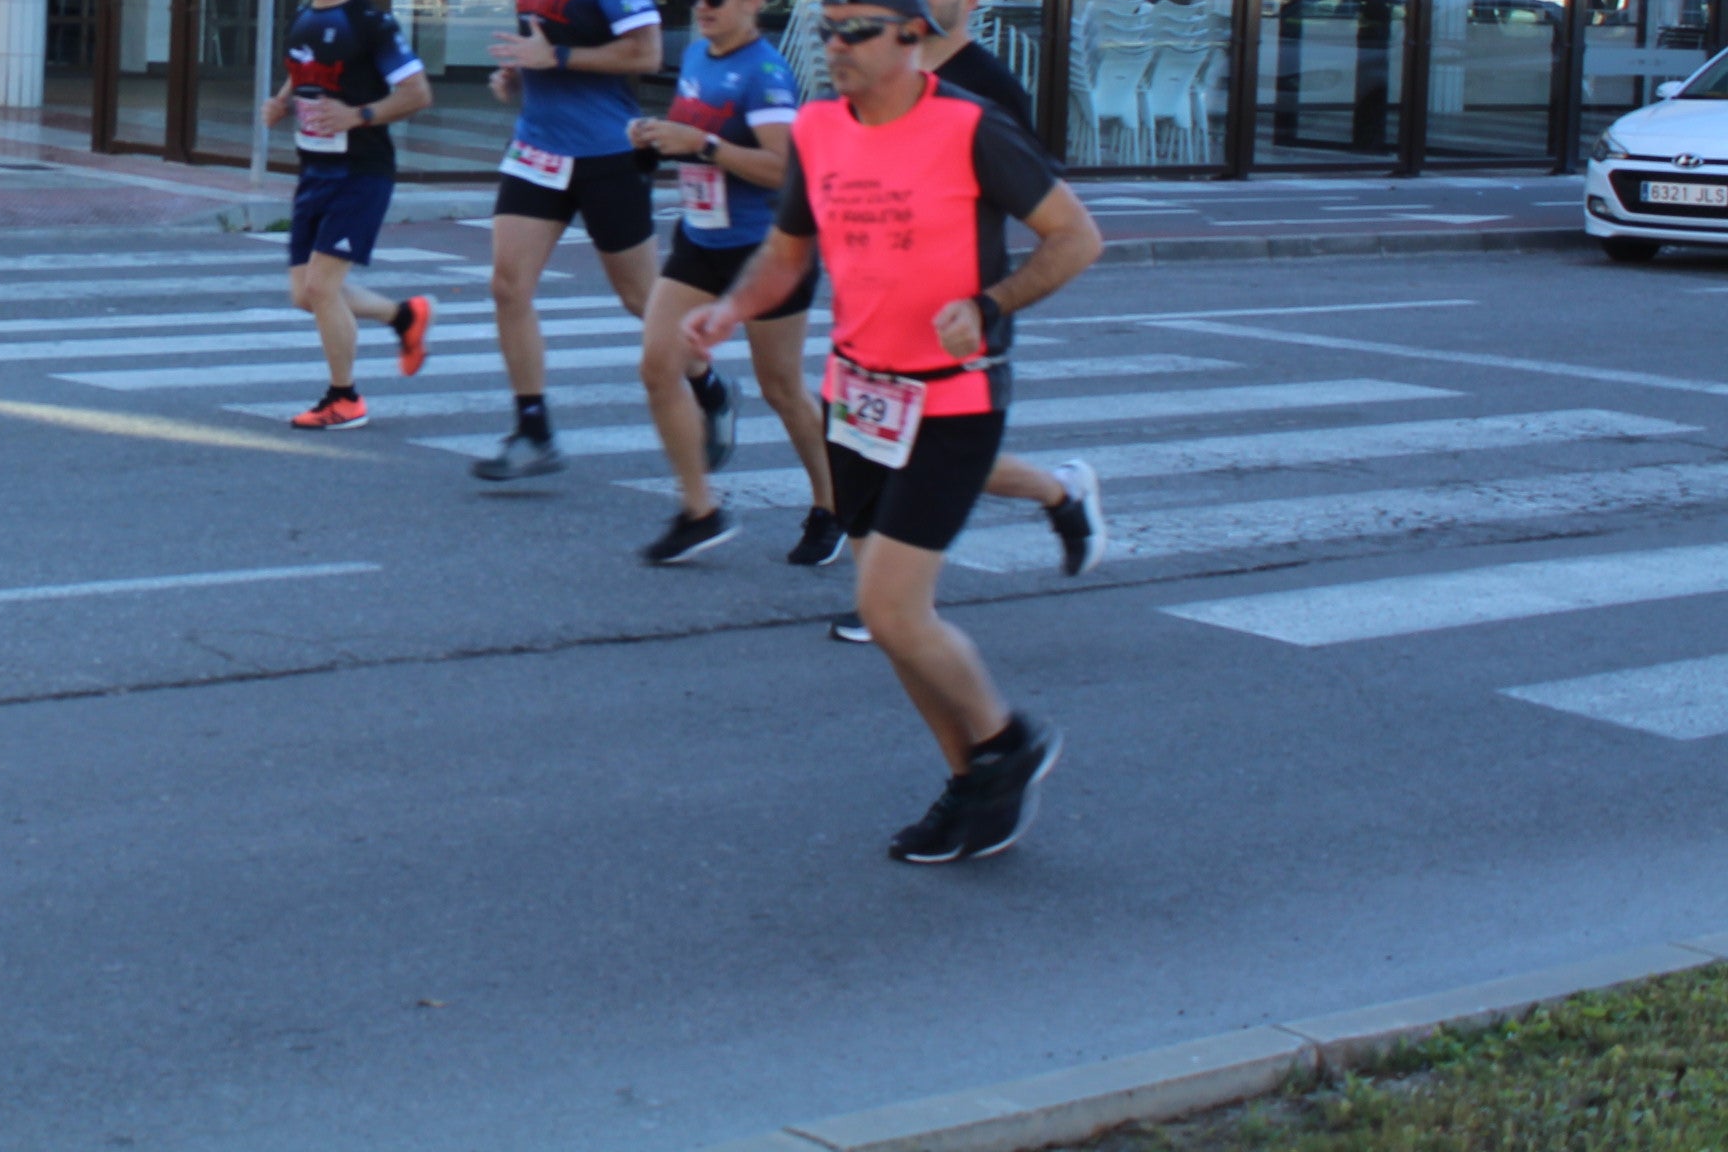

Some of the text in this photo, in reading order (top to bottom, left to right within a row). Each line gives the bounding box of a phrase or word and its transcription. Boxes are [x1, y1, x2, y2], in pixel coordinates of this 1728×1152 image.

[1651, 184, 1725, 204] 6321 JLS
[857, 393, 887, 422] 29
